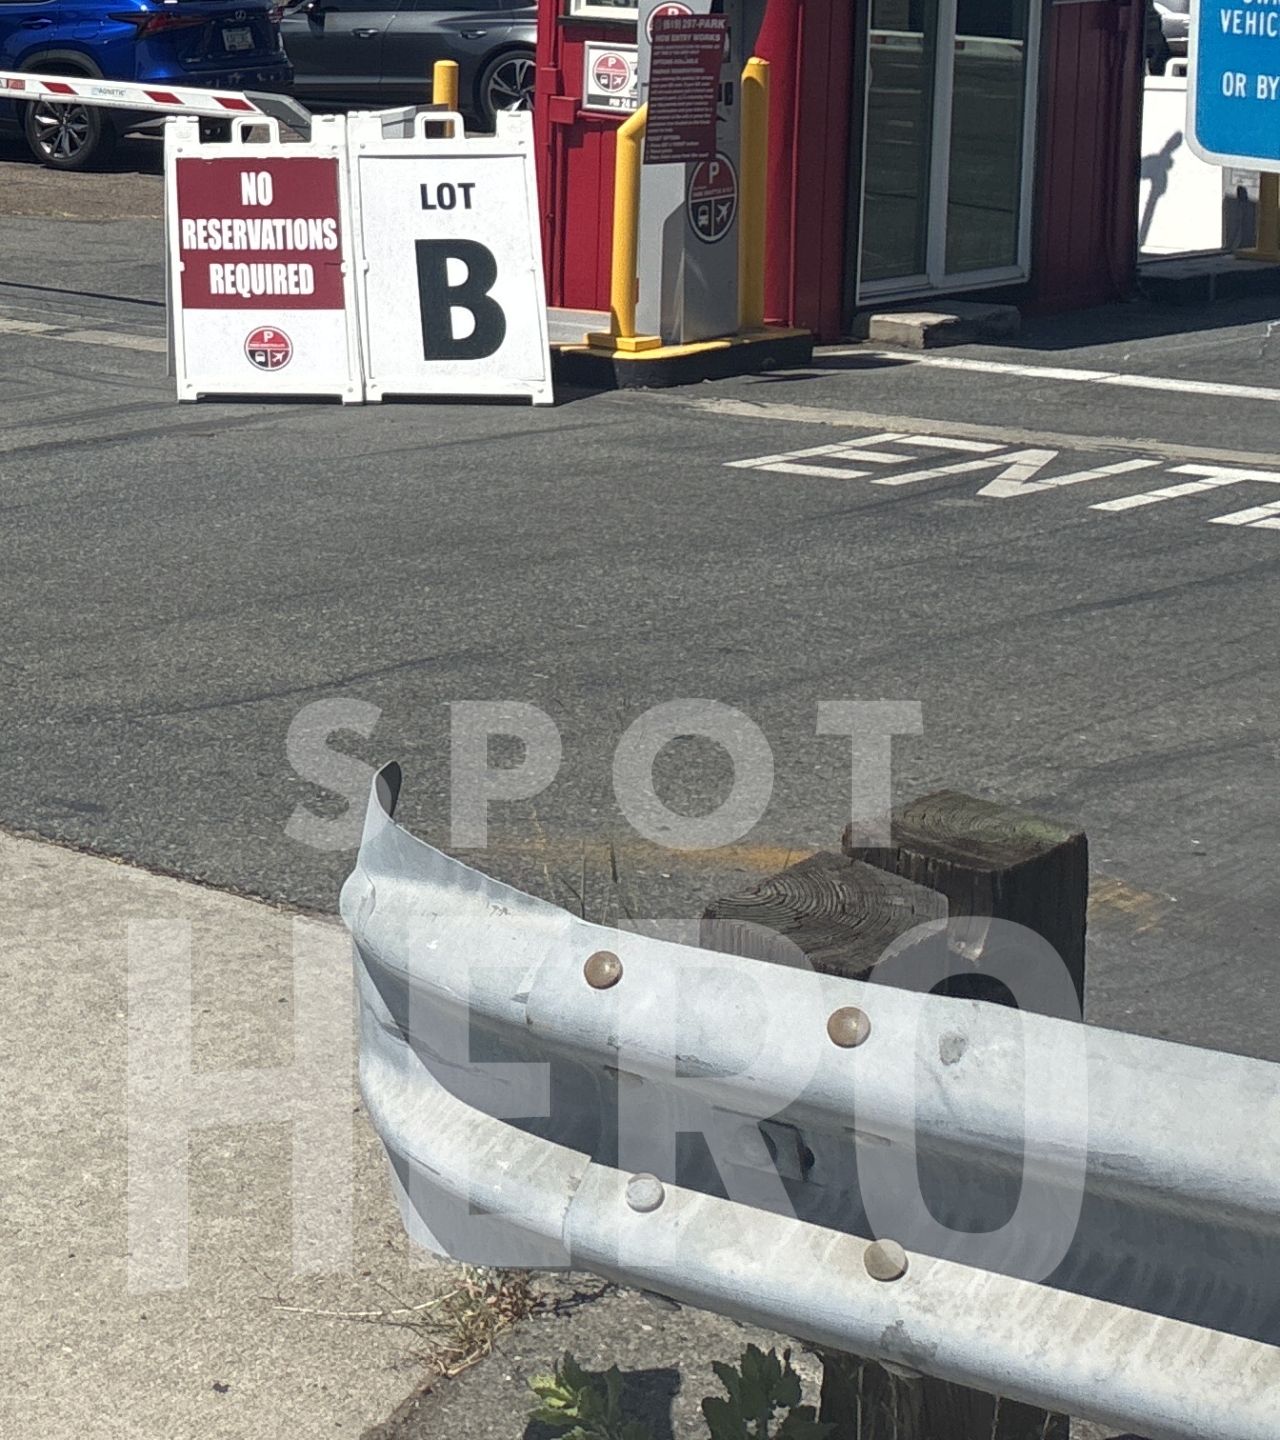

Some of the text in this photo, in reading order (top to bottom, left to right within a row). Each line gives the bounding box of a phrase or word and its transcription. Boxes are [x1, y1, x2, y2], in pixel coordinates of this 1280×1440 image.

[1220, 9, 1280, 38] VEHIC
[1222, 71, 1280, 101] OR BY
[241, 171, 274, 206] NO
[420, 182, 476, 210] LOT
[182, 218, 338, 250] RESERVATIONS
[209, 263, 315, 298] REQUIRED
[414, 239, 507, 361] B
